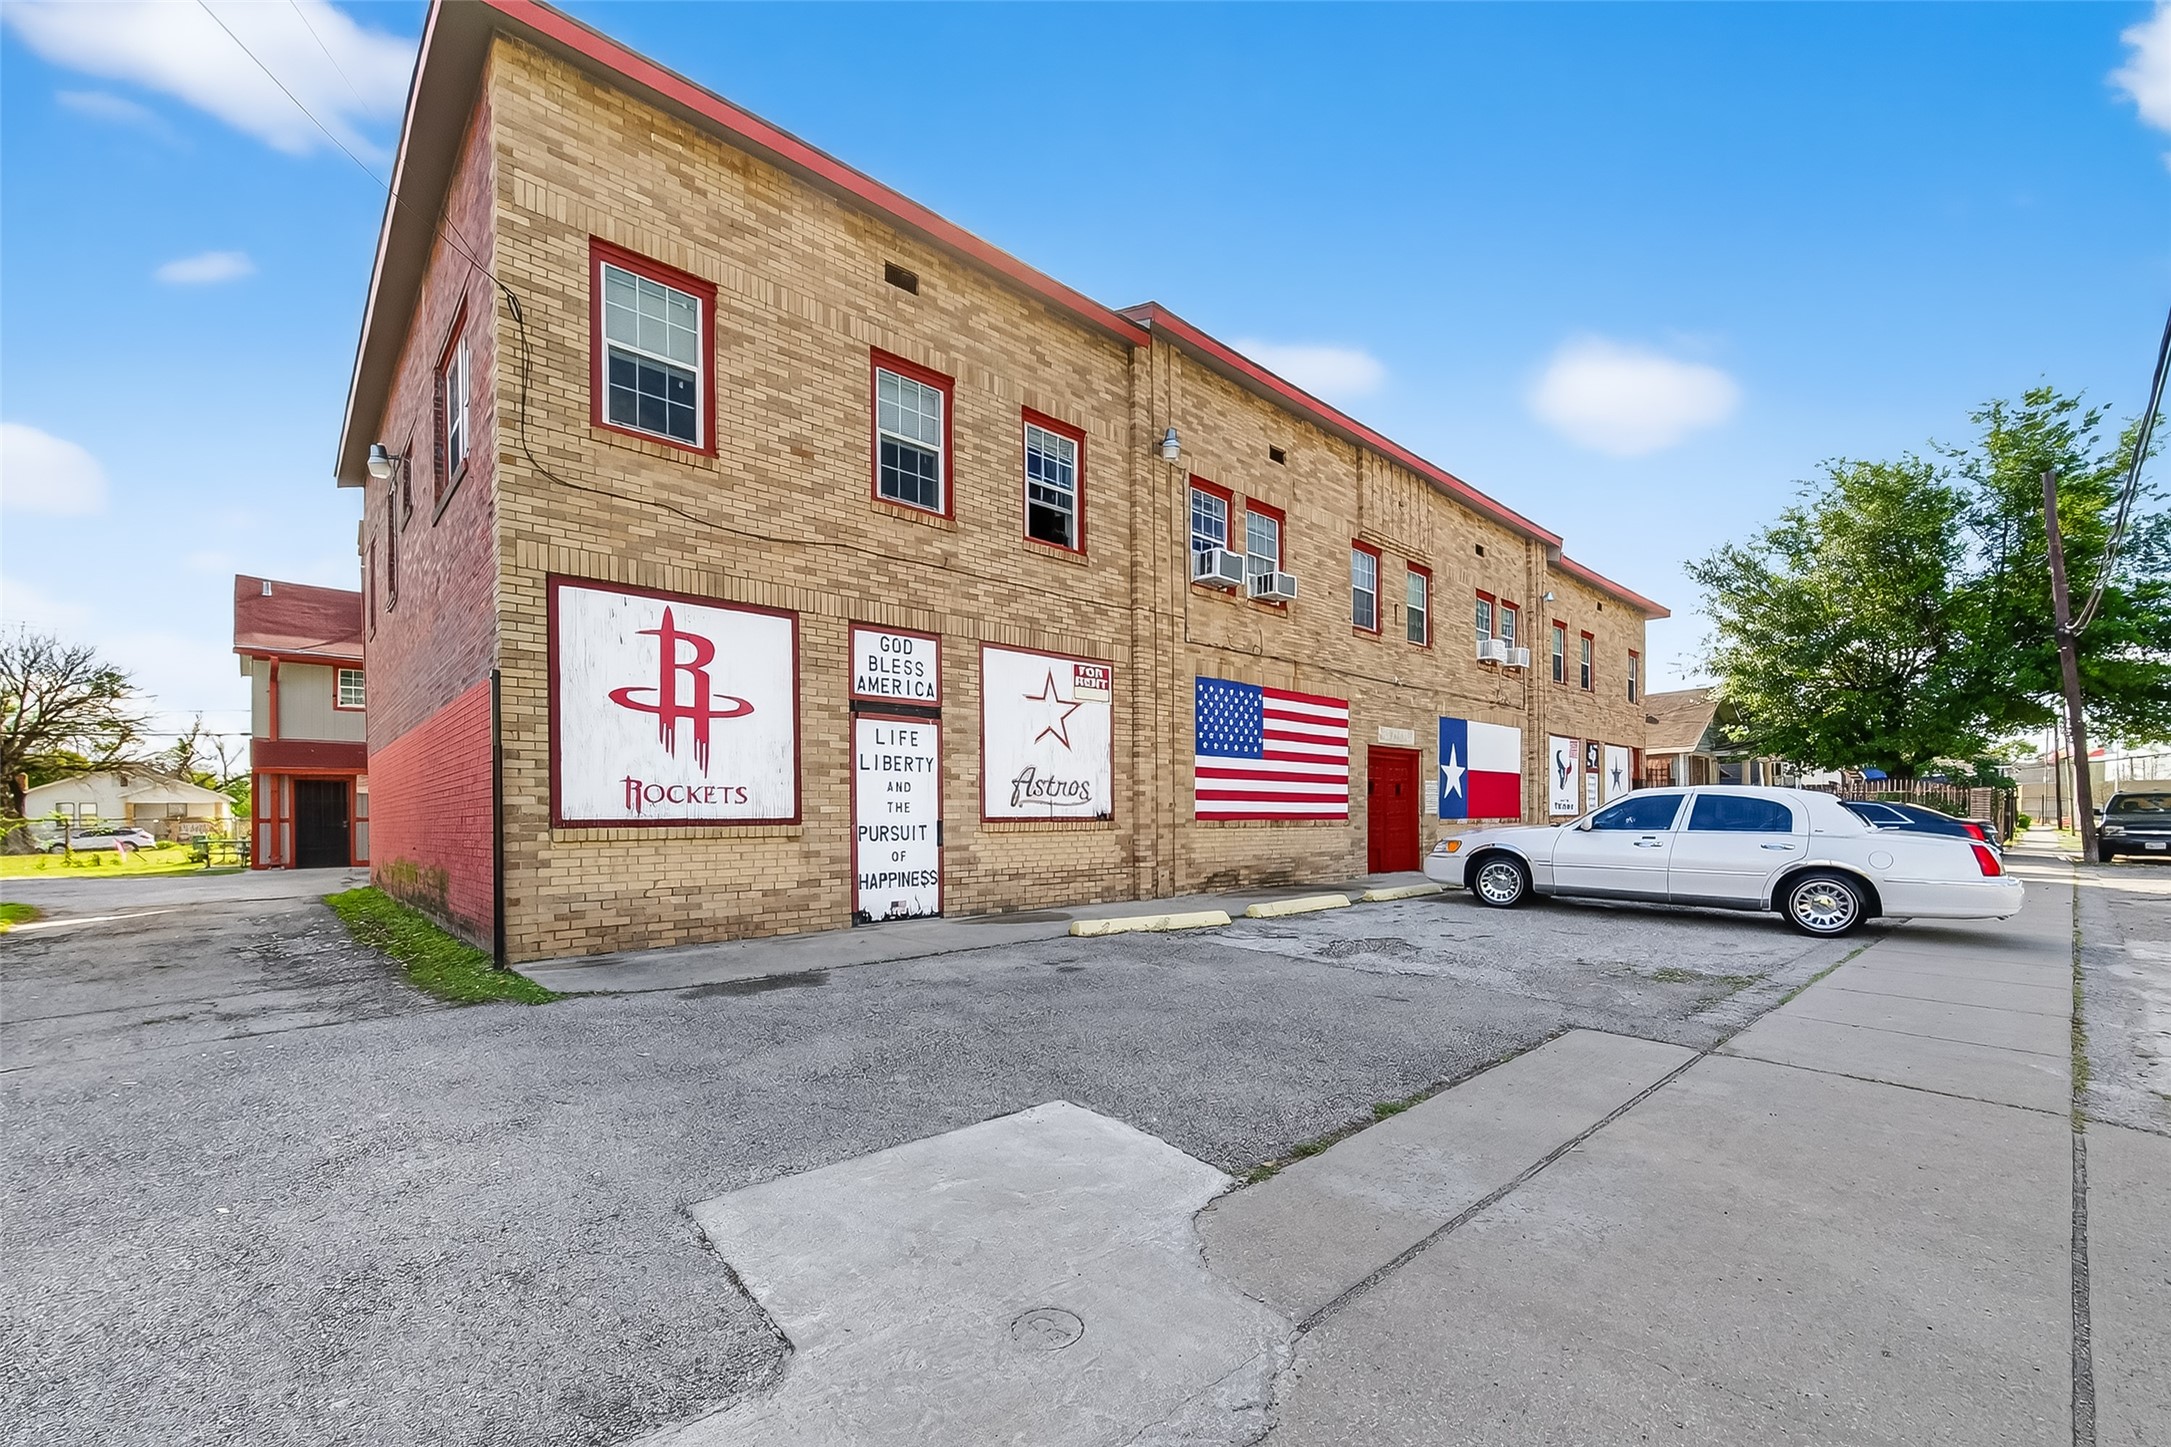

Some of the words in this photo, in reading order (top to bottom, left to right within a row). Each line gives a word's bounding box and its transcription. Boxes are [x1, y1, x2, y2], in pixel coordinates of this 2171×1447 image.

[880, 635, 912, 655] GOD
[868, 656, 924, 677] BLESS
[857, 675, 934, 698] AMERICA
[876, 727, 918, 746] LIFE
[860, 754, 934, 773] LIBERTY
[621, 774, 748, 815] ROCKETS
[887, 781, 912, 793] AND
[1010, 766, 1092, 807] Astros
[887, 801, 911, 813] THE
[858, 825, 927, 842] PURSUIT
[891, 850, 906, 862] OF
